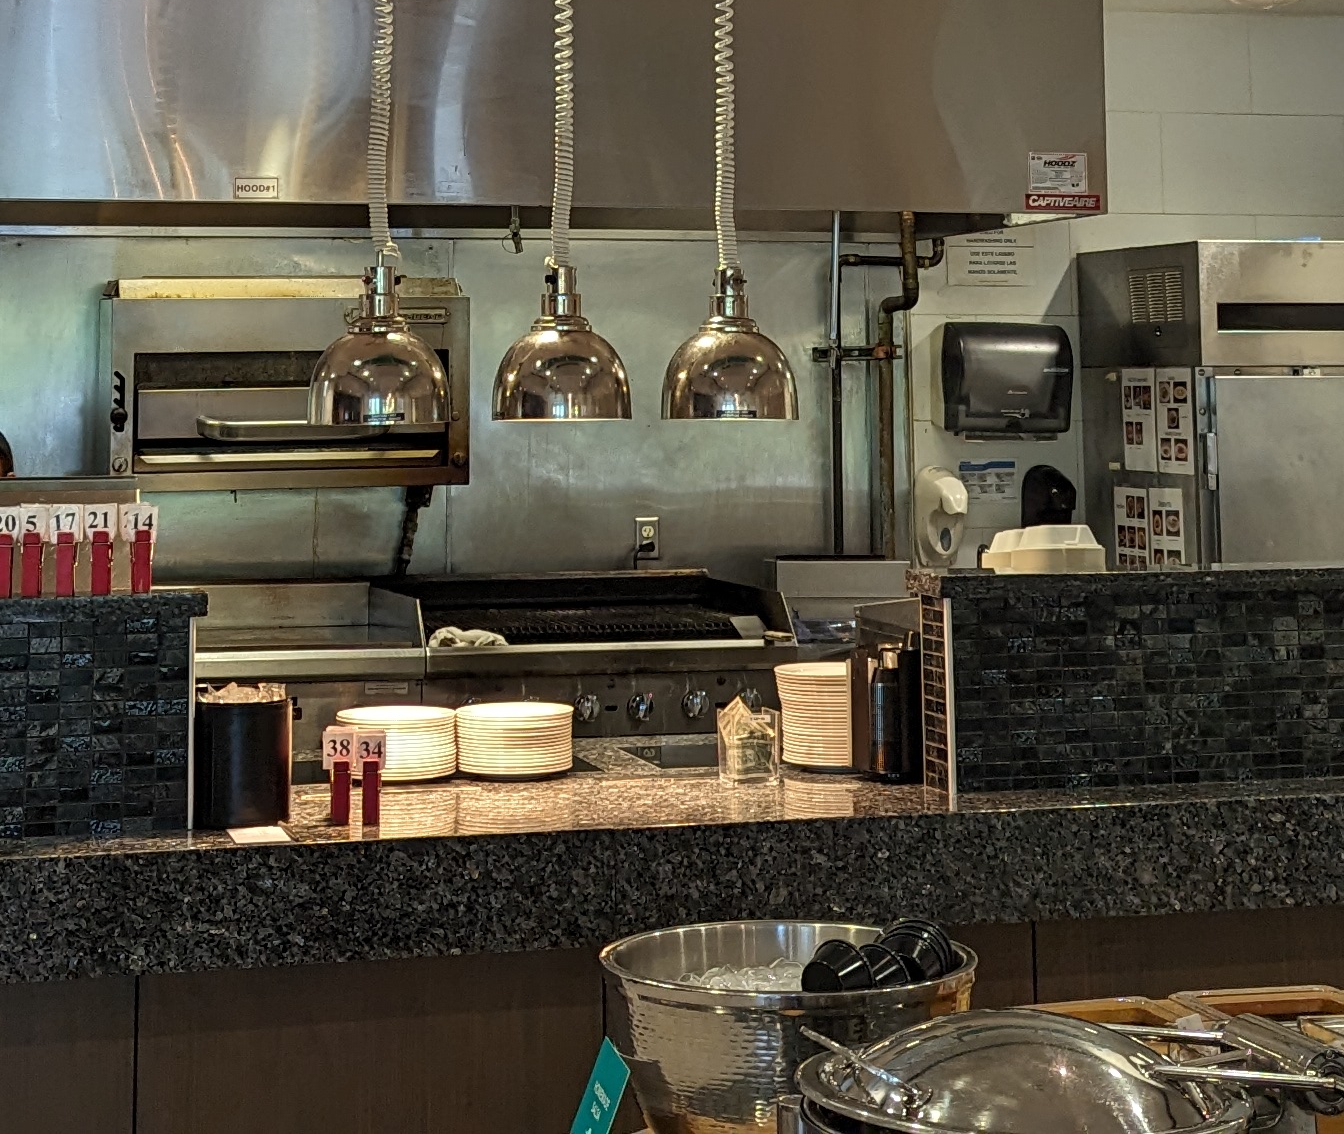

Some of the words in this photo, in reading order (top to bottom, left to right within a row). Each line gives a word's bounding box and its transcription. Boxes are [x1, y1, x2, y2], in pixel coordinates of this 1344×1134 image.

[25, 513, 37, 532] 5
[53, 512, 76, 532] 17
[87, 511, 110, 530] 21
[131, 512, 154, 531] 14
[326, 738, 351, 758] 38
[359, 740, 384, 760] 34
